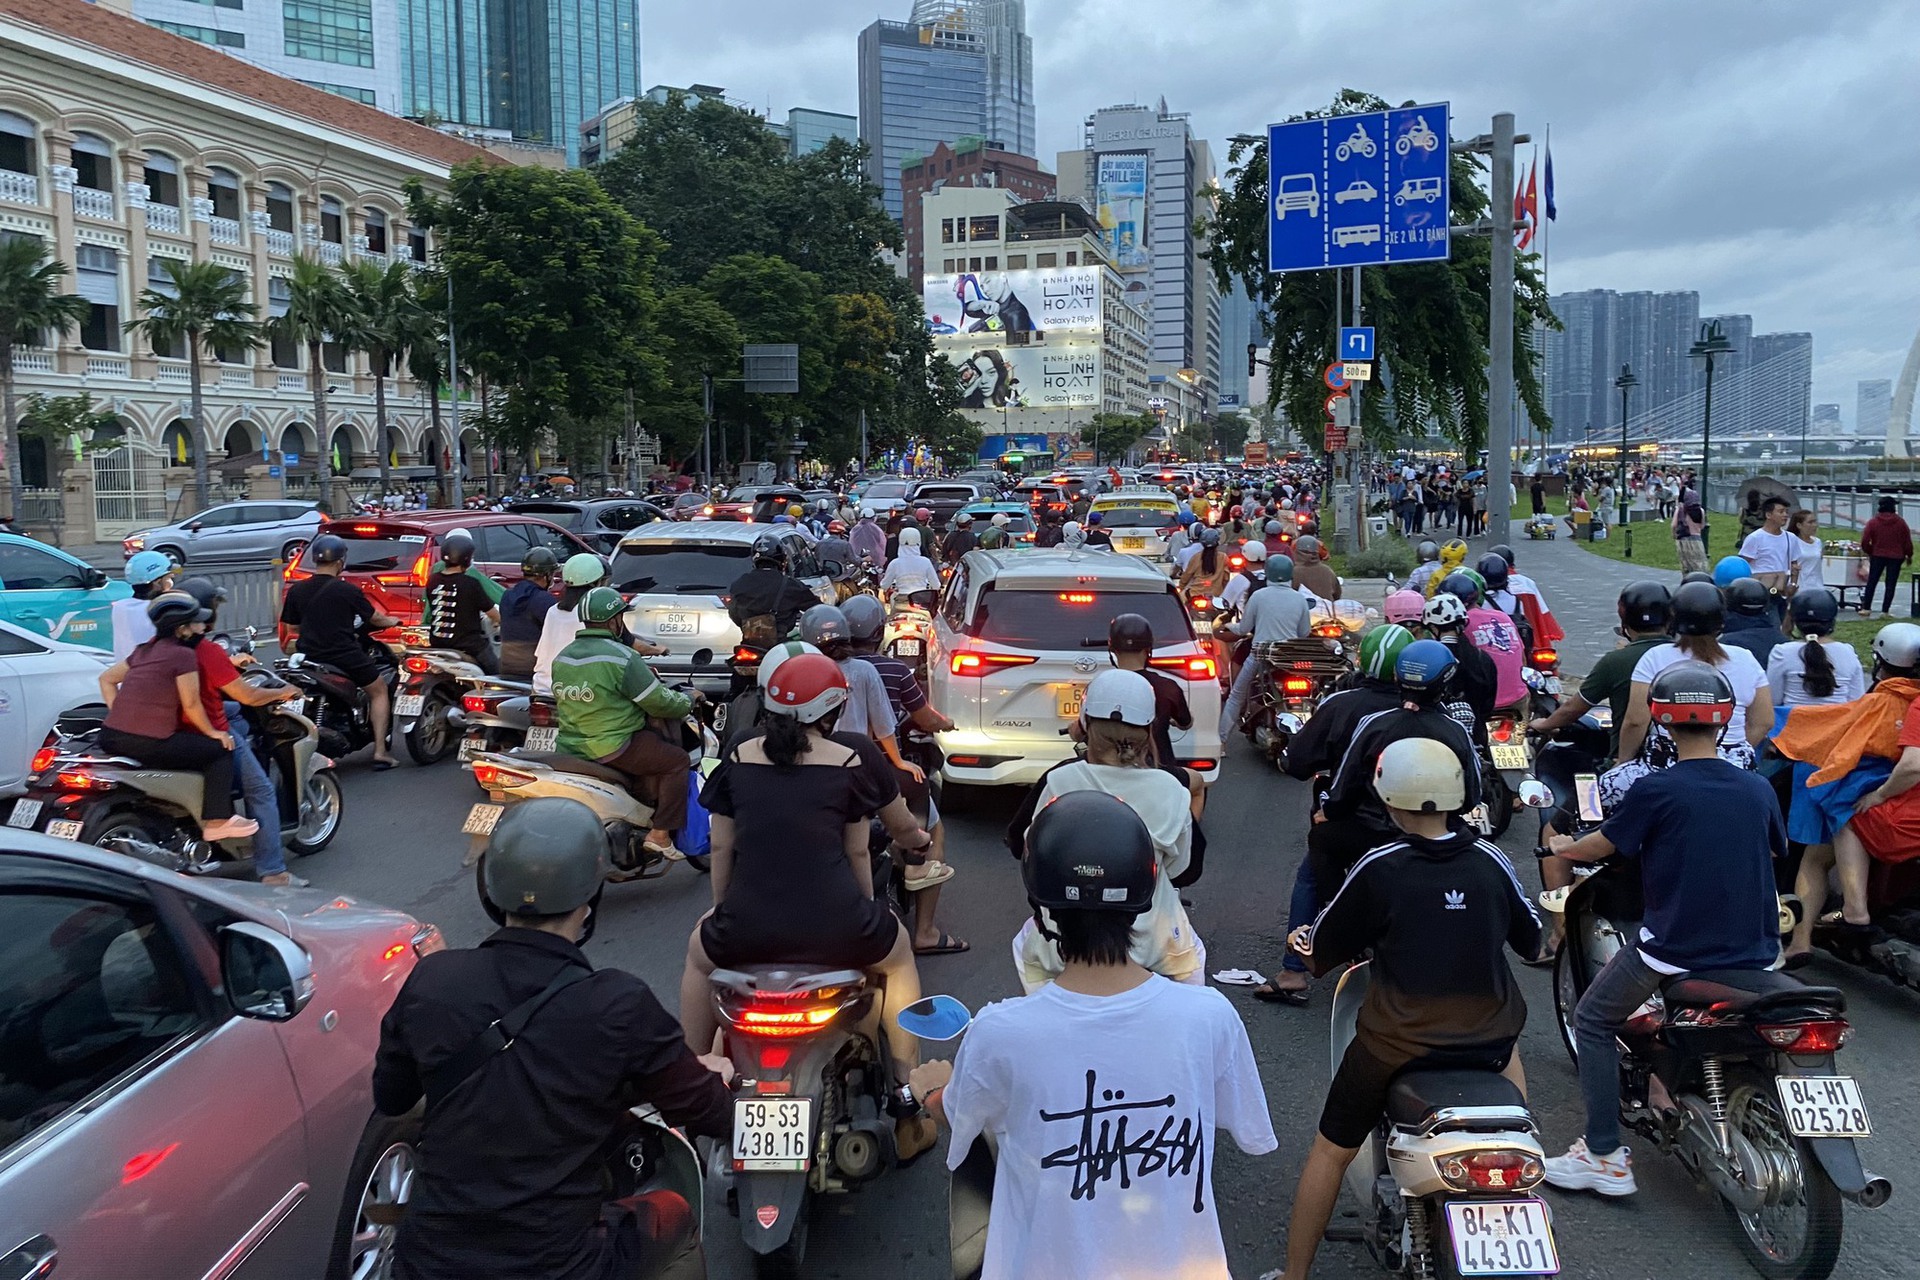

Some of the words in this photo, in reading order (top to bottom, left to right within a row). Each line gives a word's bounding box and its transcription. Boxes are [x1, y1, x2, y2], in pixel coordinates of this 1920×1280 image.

[1099, 129, 1136, 144] LIBERTY
[1137, 126, 1181, 140] CENTRAL
[1101, 170, 1129, 183] CHILL
[1389, 231, 1399, 244] XE
[1400, 230, 1406, 243] 2
[1408, 226, 1417, 243] VÀ
[1419, 229, 1424, 242] 3
[1426, 225, 1446, 241] BÁNH
[1044, 284, 1094, 298] LINH
[1044, 316, 1071, 325] Galaxy
[1077, 315, 1095, 324] Flip5
[1044, 363, 1094, 375] LINH
[1044, 395, 1071, 403] Galaxy
[1077, 393, 1095, 402] Flip5
[668, 613, 686, 623] 60K
[660, 623, 693, 633] 058.22
[552, 681, 594, 703] Grab
[992, 720, 1032, 728] AVANZA
[1790, 1081, 1849, 1105] 84-H1
[745, 1103, 799, 1128] 59-S3
[1791, 1107, 1866, 1133] 025.28
[738, 1131, 804, 1156] 438.16
[1462, 1206, 1533, 1236] 84-K1
[1464, 1239, 1549, 1270] 443.01
